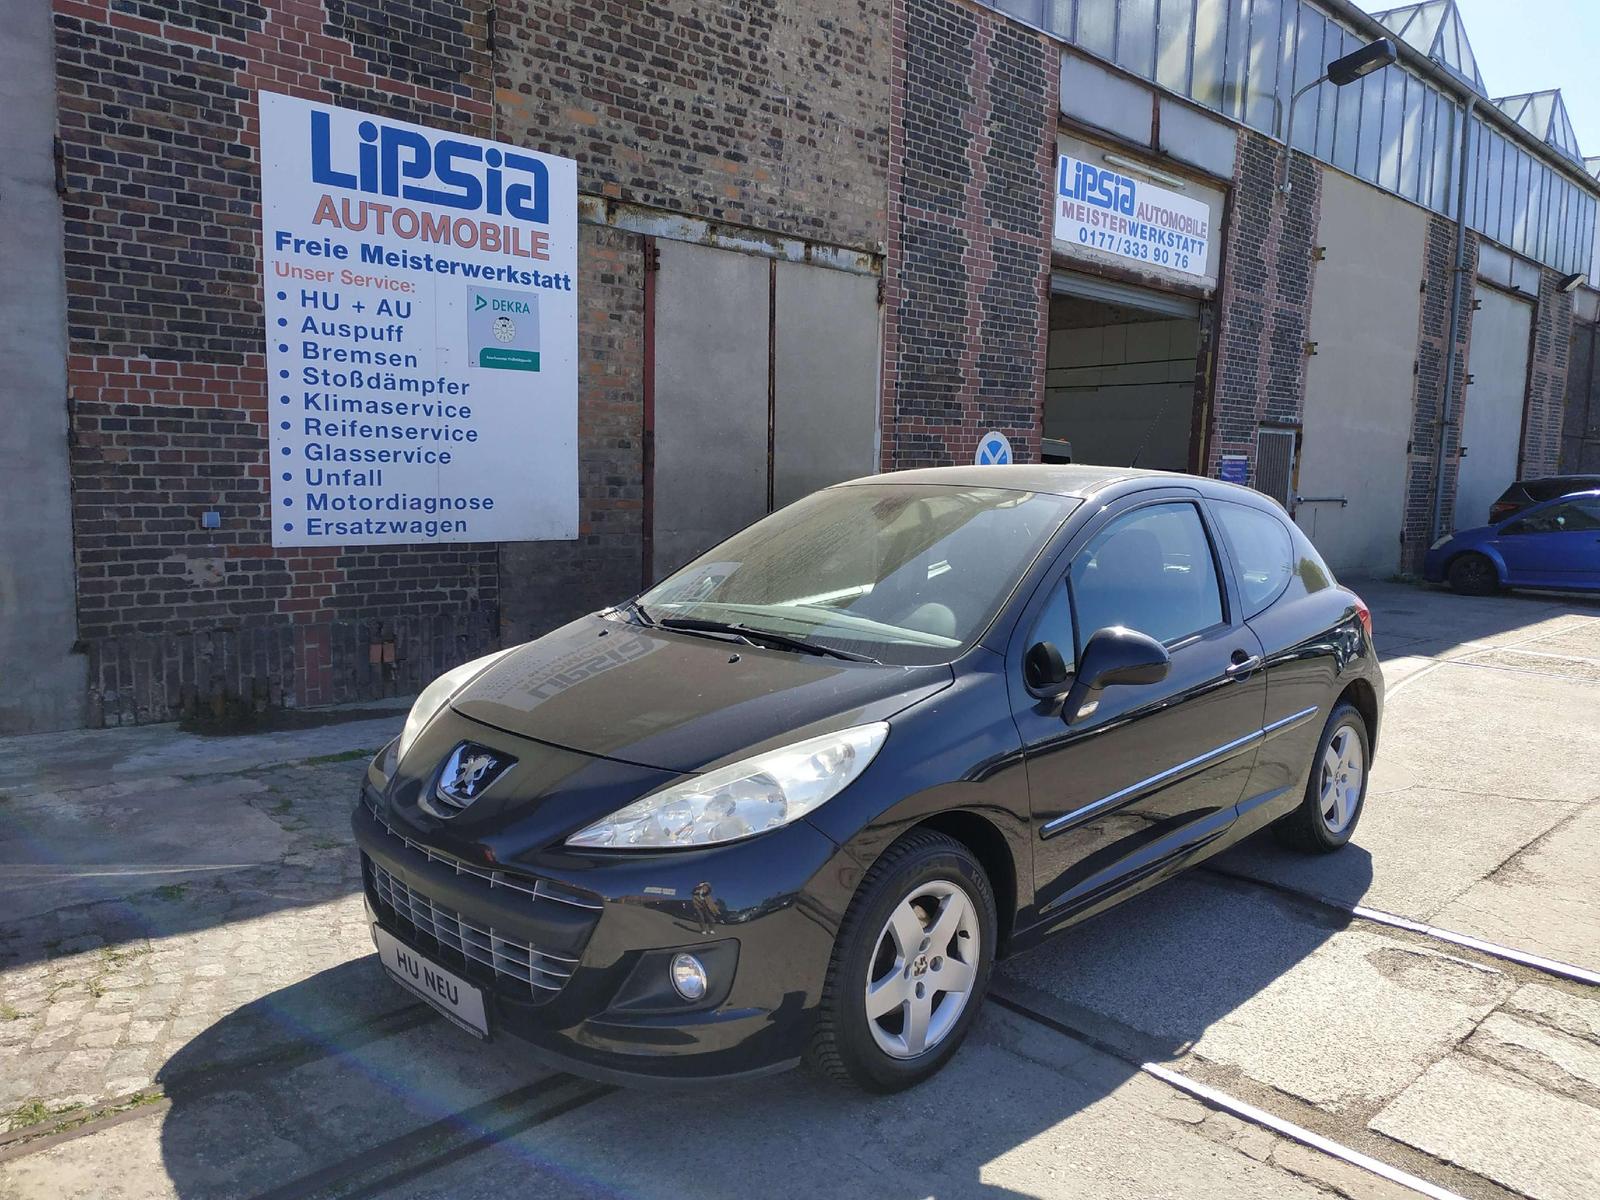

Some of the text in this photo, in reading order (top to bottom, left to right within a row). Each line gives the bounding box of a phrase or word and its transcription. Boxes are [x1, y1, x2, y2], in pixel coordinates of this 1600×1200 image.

[312, 194, 550, 261] AUTOMOBILE
[1062, 201, 1205, 256] MEISTERWERKSTATT
[1136, 202, 1208, 239] AUTOMOBILE
[275, 230, 571, 291] Freie Meisterwerkstatt
[1153, 247, 1169, 264] 90
[1174, 253, 1189, 269] 76
[275, 260, 416, 293] Unser Service:
[300, 289, 340, 311] HU
[376, 298, 412, 318] AU
[492, 299, 531, 314] DEKRA
[301, 316, 404, 342] Auspuff
[302, 341, 418, 368] Bremsen
[302, 366, 470, 396] Stoßdämpfer
[304, 392, 472, 418] Klimaservice
[304, 418, 478, 442] Reifenservice
[304, 443, 452, 465] Glasservice
[305, 468, 383, 487] Unfall
[306, 493, 495, 514] Motordiagnose
[307, 518, 467, 538] Ersatzwagen
[396, 948, 459, 1006] HU NEU
